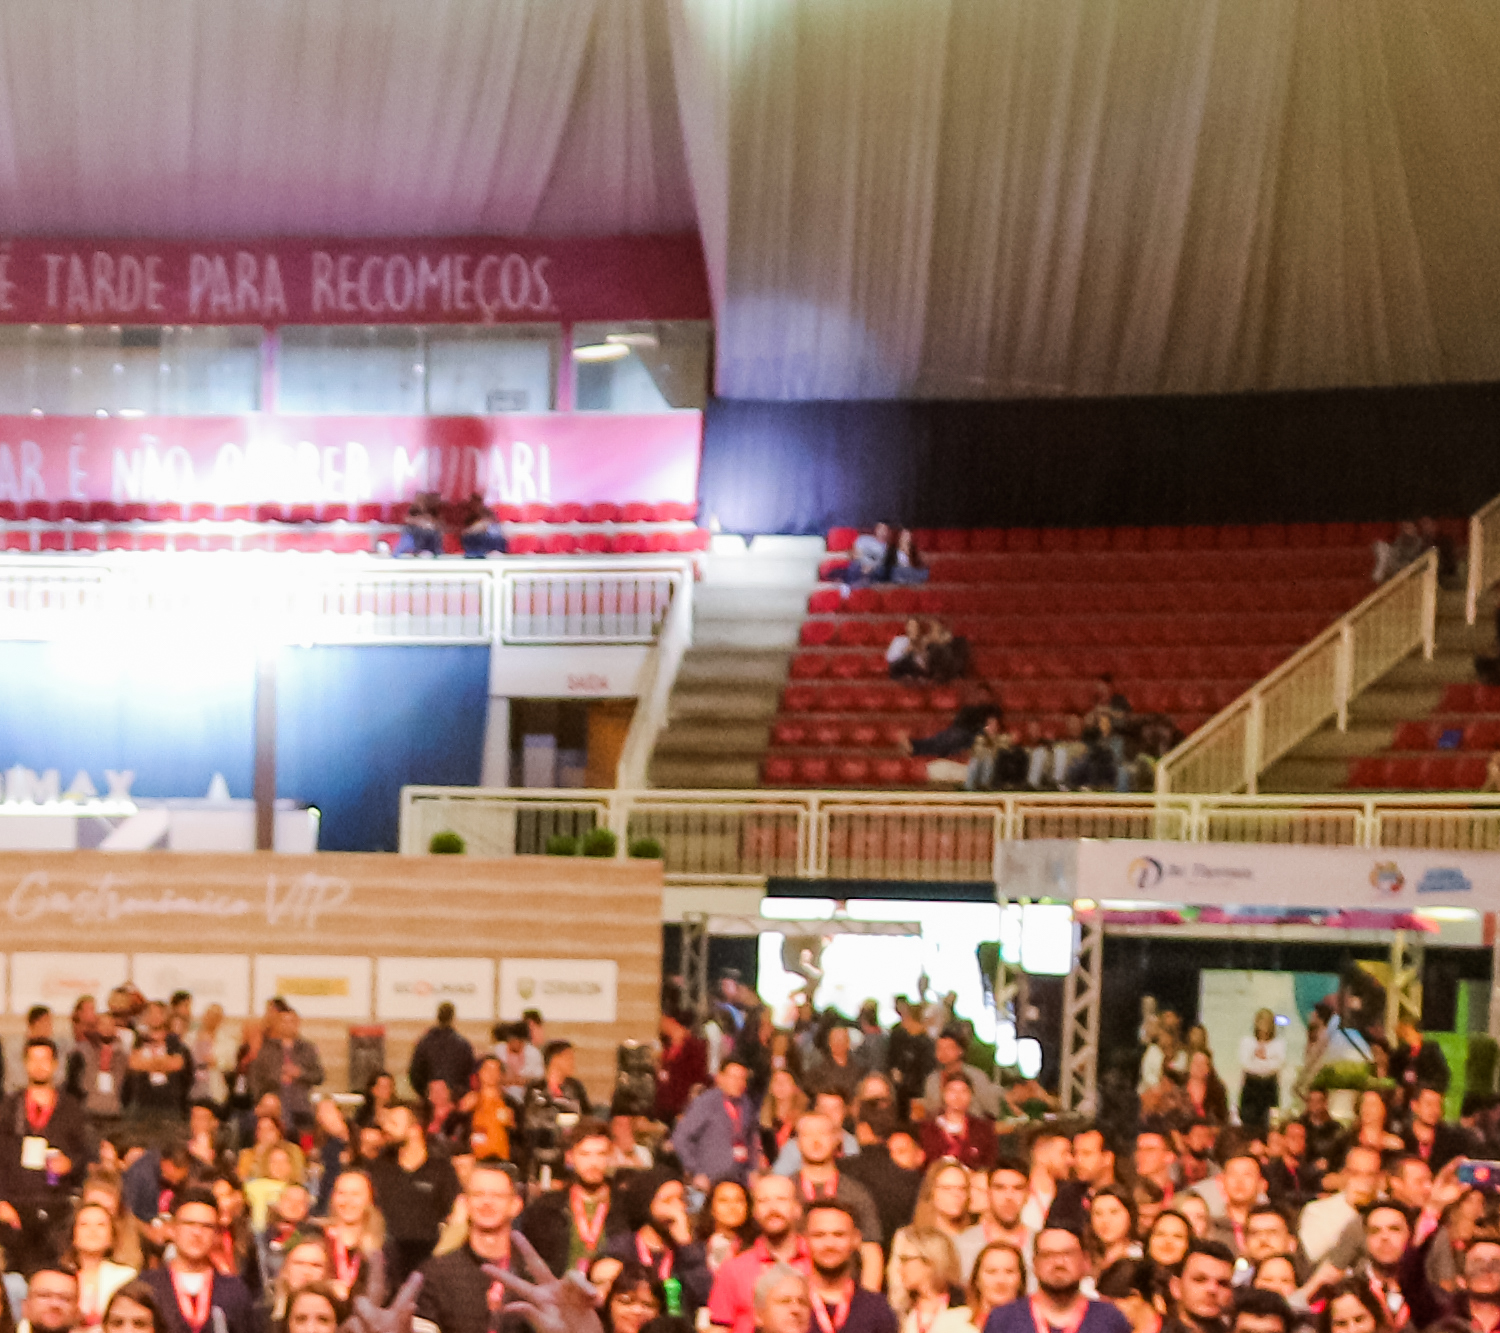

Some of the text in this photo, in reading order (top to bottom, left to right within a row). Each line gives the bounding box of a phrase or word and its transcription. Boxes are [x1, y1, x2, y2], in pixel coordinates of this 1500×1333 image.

[0, 238, 14, 312] É
[43, 253, 167, 313] TARDE
[188, 253, 288, 315] PARA
[112, 434, 196, 500] NÃO
